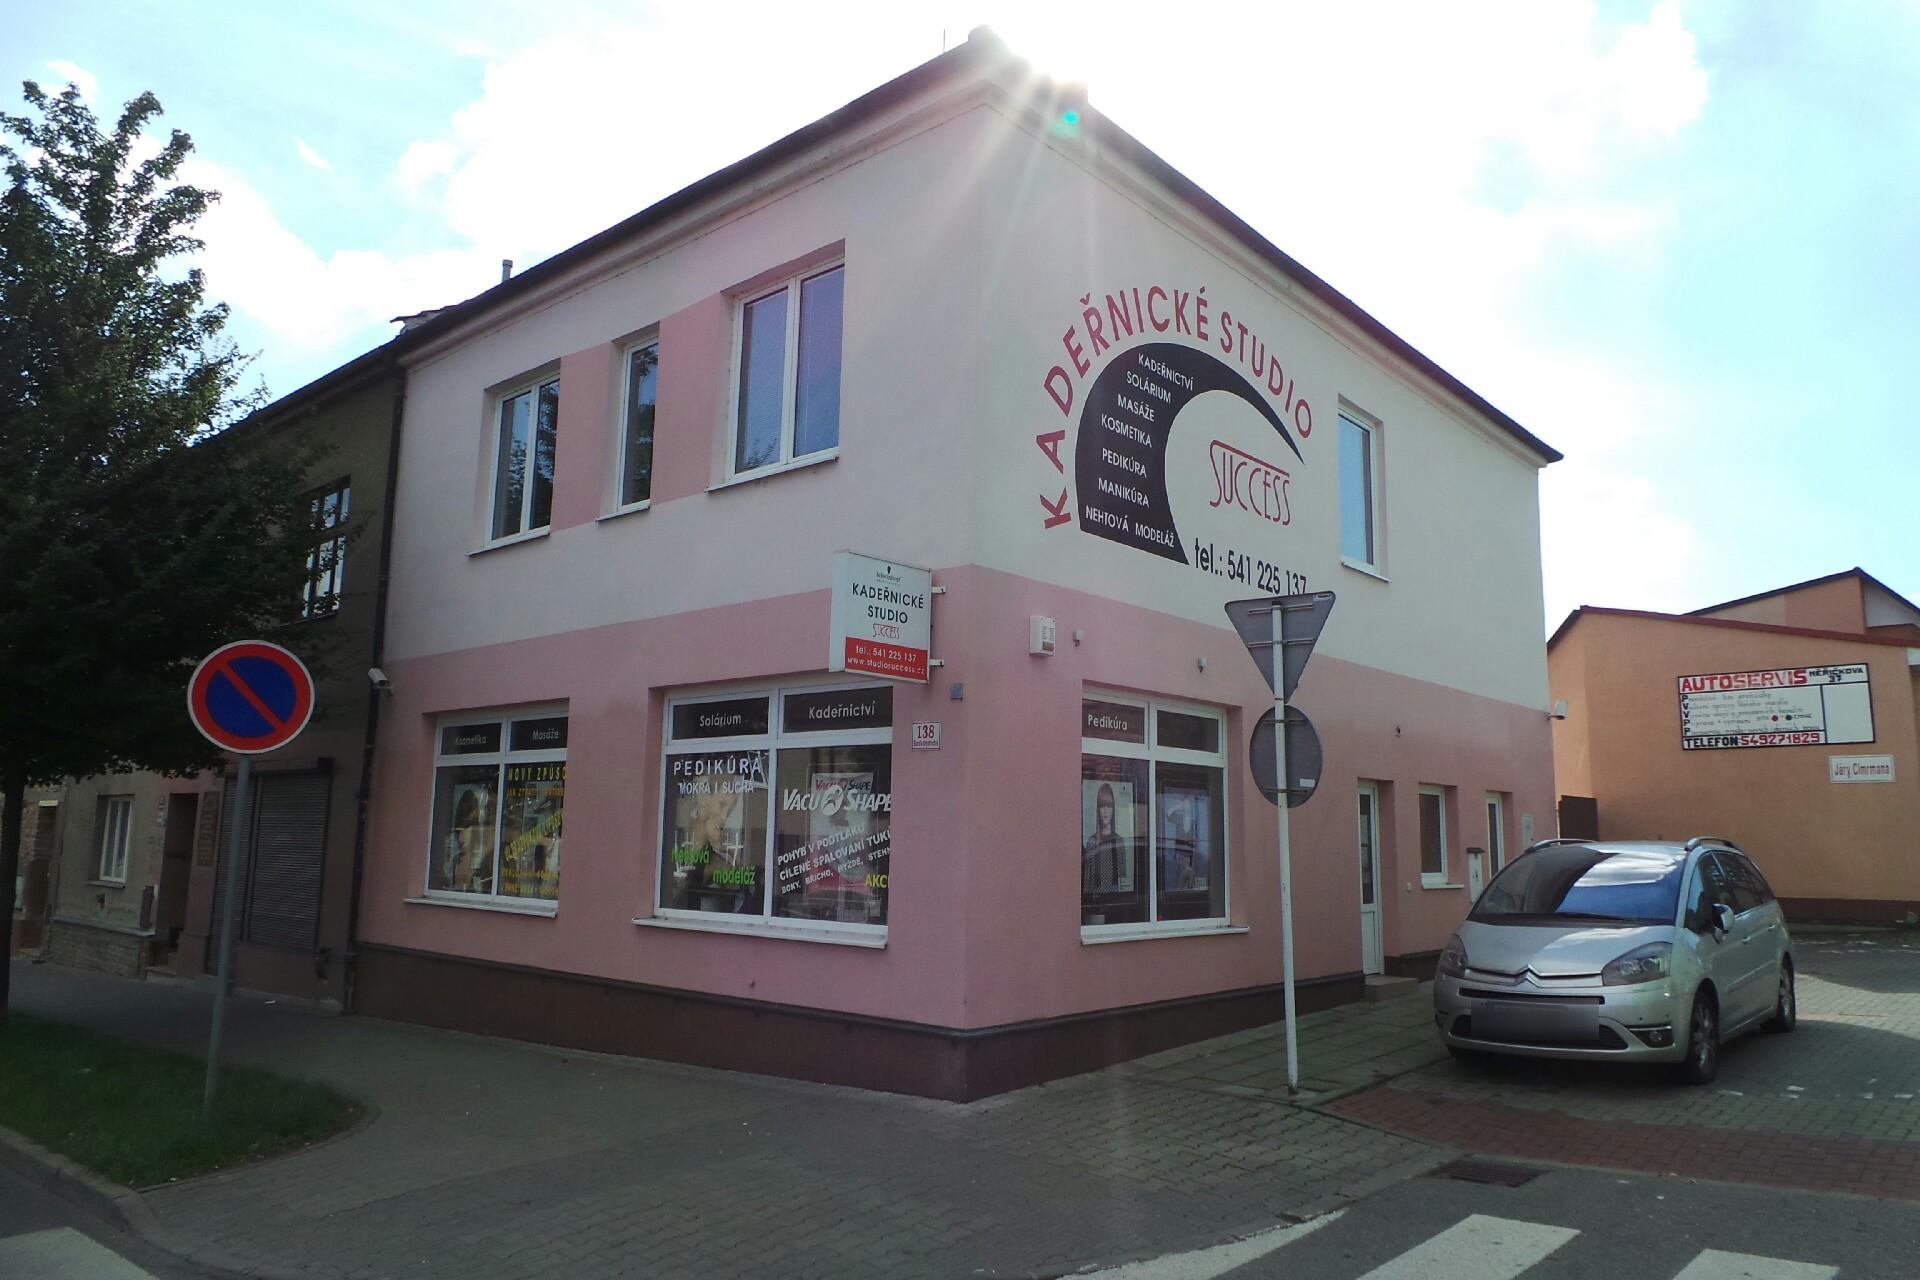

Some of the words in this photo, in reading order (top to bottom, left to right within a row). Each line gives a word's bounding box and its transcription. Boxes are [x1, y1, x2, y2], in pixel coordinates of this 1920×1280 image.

[1138, 353, 1194, 391] KADEŘNICTVÍ
[1126, 371, 1171, 404] SOLÁRIUM
[1036, 286, 1209, 529] KADEŘNICKÉ
[1220, 311, 1312, 438] STUDIO
[1118, 394, 1155, 422] MASÁŽE
[1101, 413, 1152, 448] KOSMETIKA
[1102, 448, 1147, 478] PEDIKÚRA
[1098, 477, 1149, 508] MANIKÚRA
[1210, 440, 1290, 526] SUCCESS
[1085, 505, 1129, 532] NEHTOVÁ
[1135, 522, 1175, 547] MODELÁŽ
[1195, 538, 1222, 576] tel.:
[1228, 550, 1251, 585] 541
[1258, 560, 1280, 594] 225
[1286, 570, 1307, 596] 137
[852, 582, 924, 609] KADEŘNICKÉ
[867, 605, 908, 624] STUDIO
[873, 622, 899, 640] SUCCESS
[873, 648, 886, 658] 541
[888, 651, 901, 660] 225
[904, 653, 917, 663] 137
[1682, 669, 1808, 692] AUTOSERVIS
[699, 713, 742, 727] Solárium
[808, 700, 876, 719] Kadeřnictví
[1088, 714, 1128, 731] Pedikúra
[917, 724, 935, 739] 138
[1741, 732, 1820, 747] 549271829
[673, 755, 762, 776] PEDIKÚRA
[848, 779, 871, 790] SHAPE
[778, 847, 807, 866] POHYB
[817, 823, 864, 850] PODTLAKU
